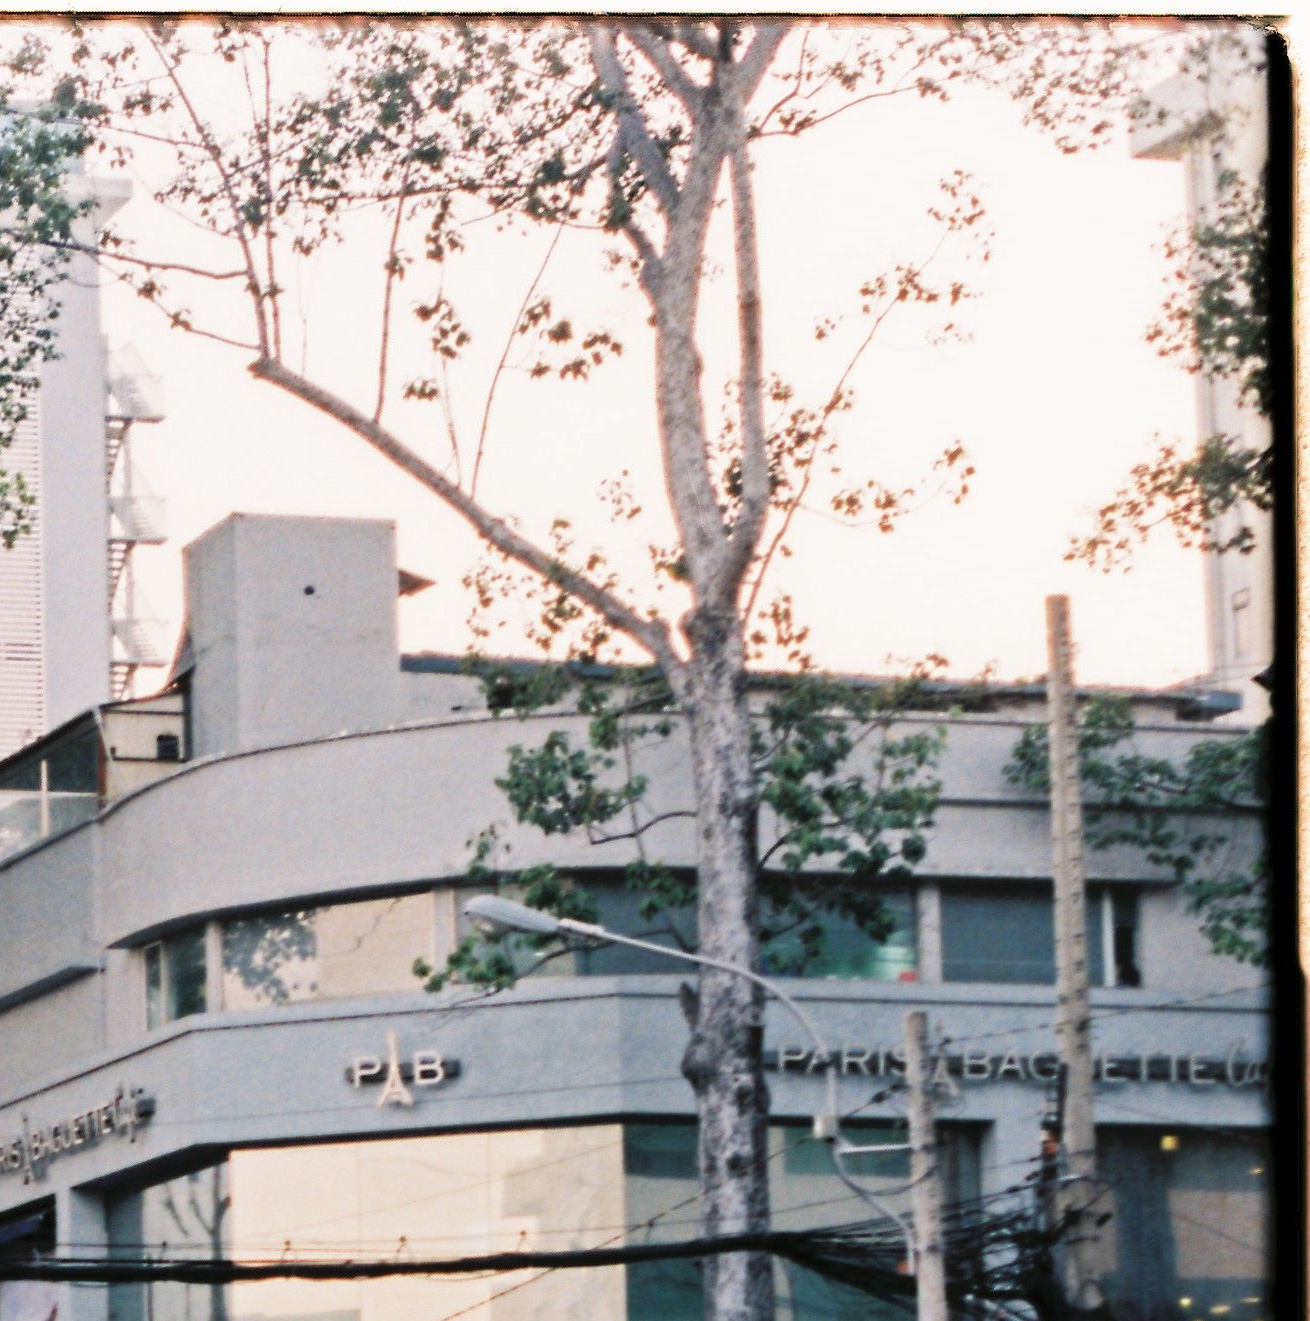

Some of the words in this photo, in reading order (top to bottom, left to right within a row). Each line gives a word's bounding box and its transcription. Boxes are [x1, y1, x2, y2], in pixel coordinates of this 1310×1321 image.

[354, 1057, 381, 1088] P
[414, 1050, 444, 1085] B
[963, 1048, 1217, 1084] BAGETTE
